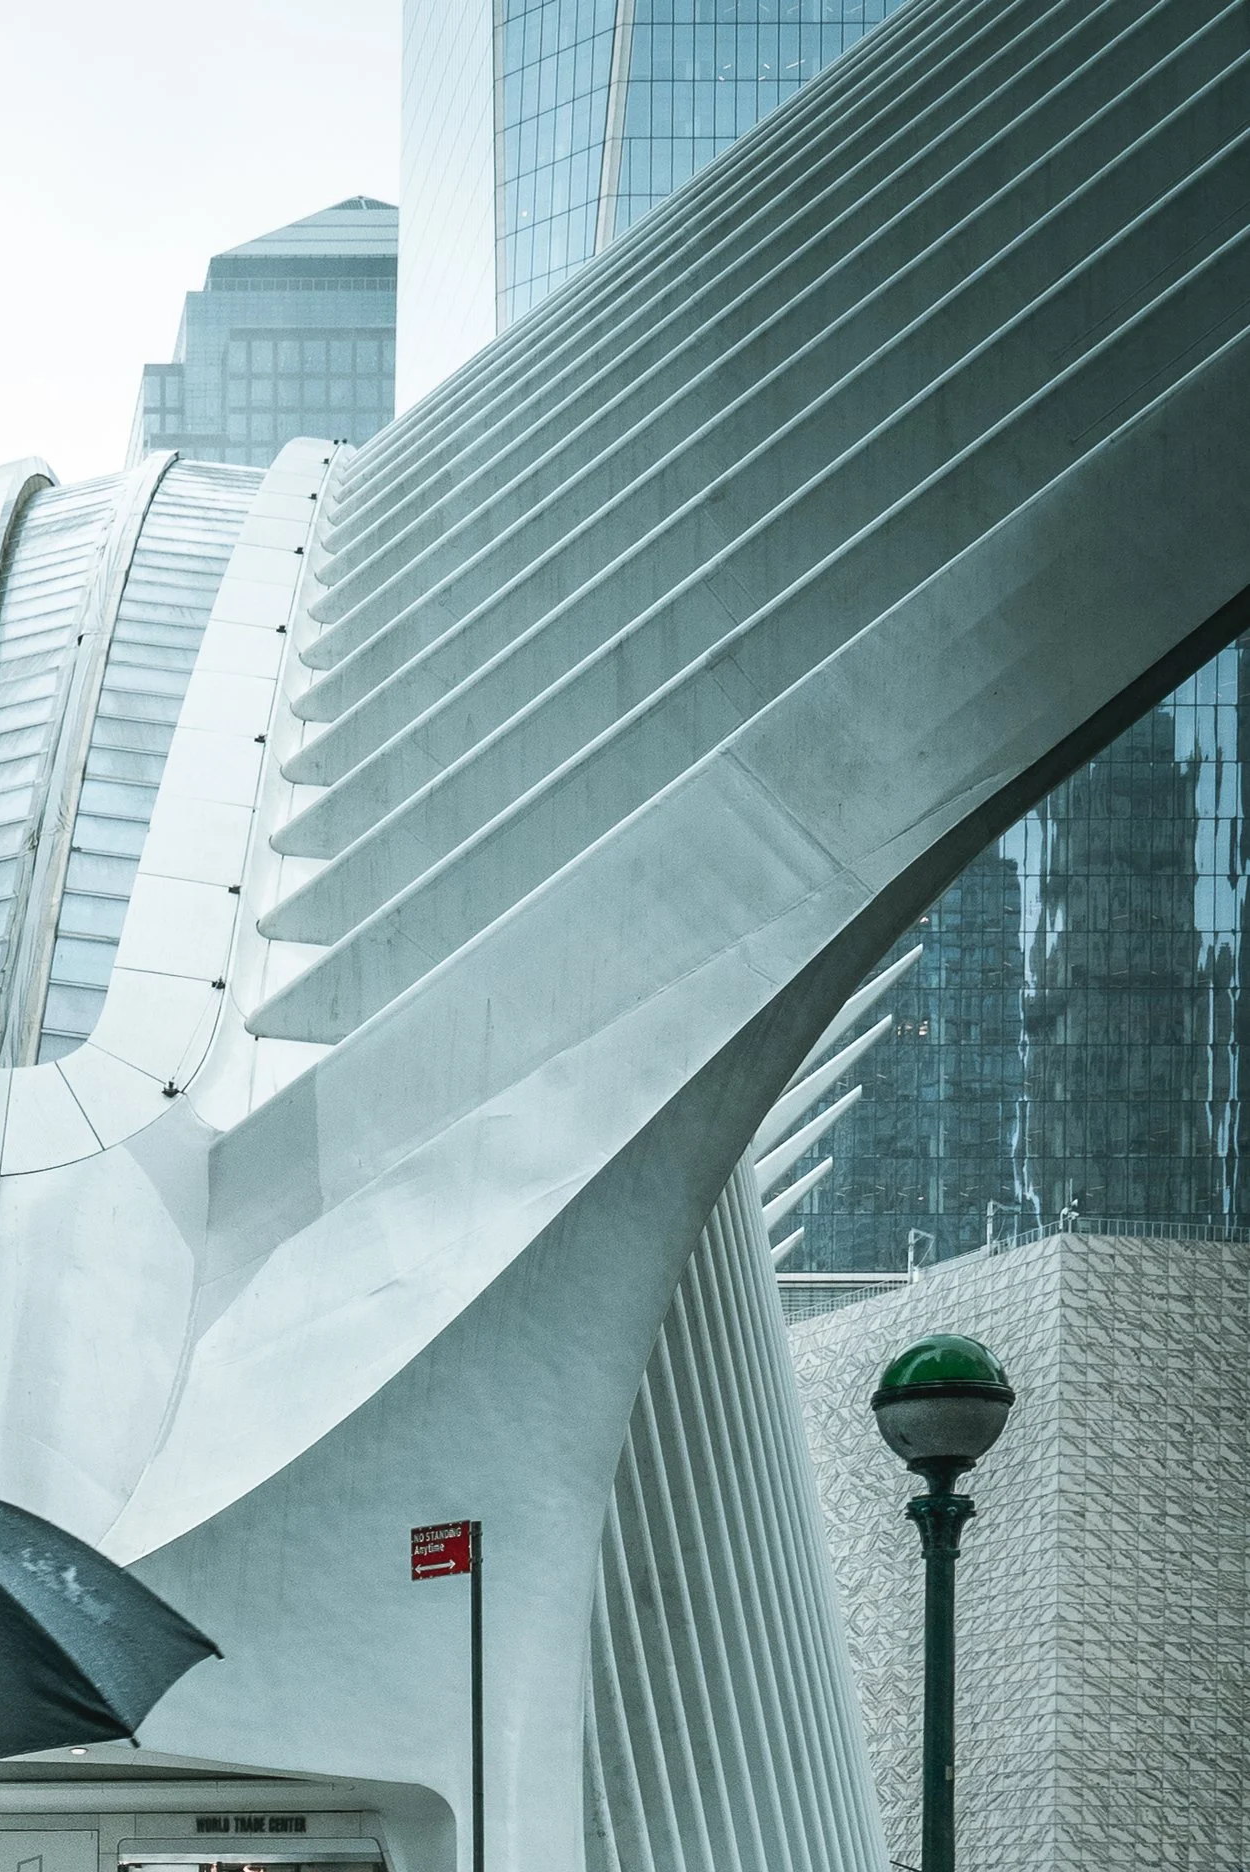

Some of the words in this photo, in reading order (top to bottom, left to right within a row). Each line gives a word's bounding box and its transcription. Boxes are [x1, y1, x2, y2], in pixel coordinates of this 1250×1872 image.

[413, 1533, 425, 1543] NO
[426, 1526, 462, 1542] STANDING
[414, 1542, 445, 1556] Anytime
[196, 1817, 230, 1833] WORLD
[234, 1817, 266, 1833] TRADE
[269, 1817, 306, 1833] CENTER
